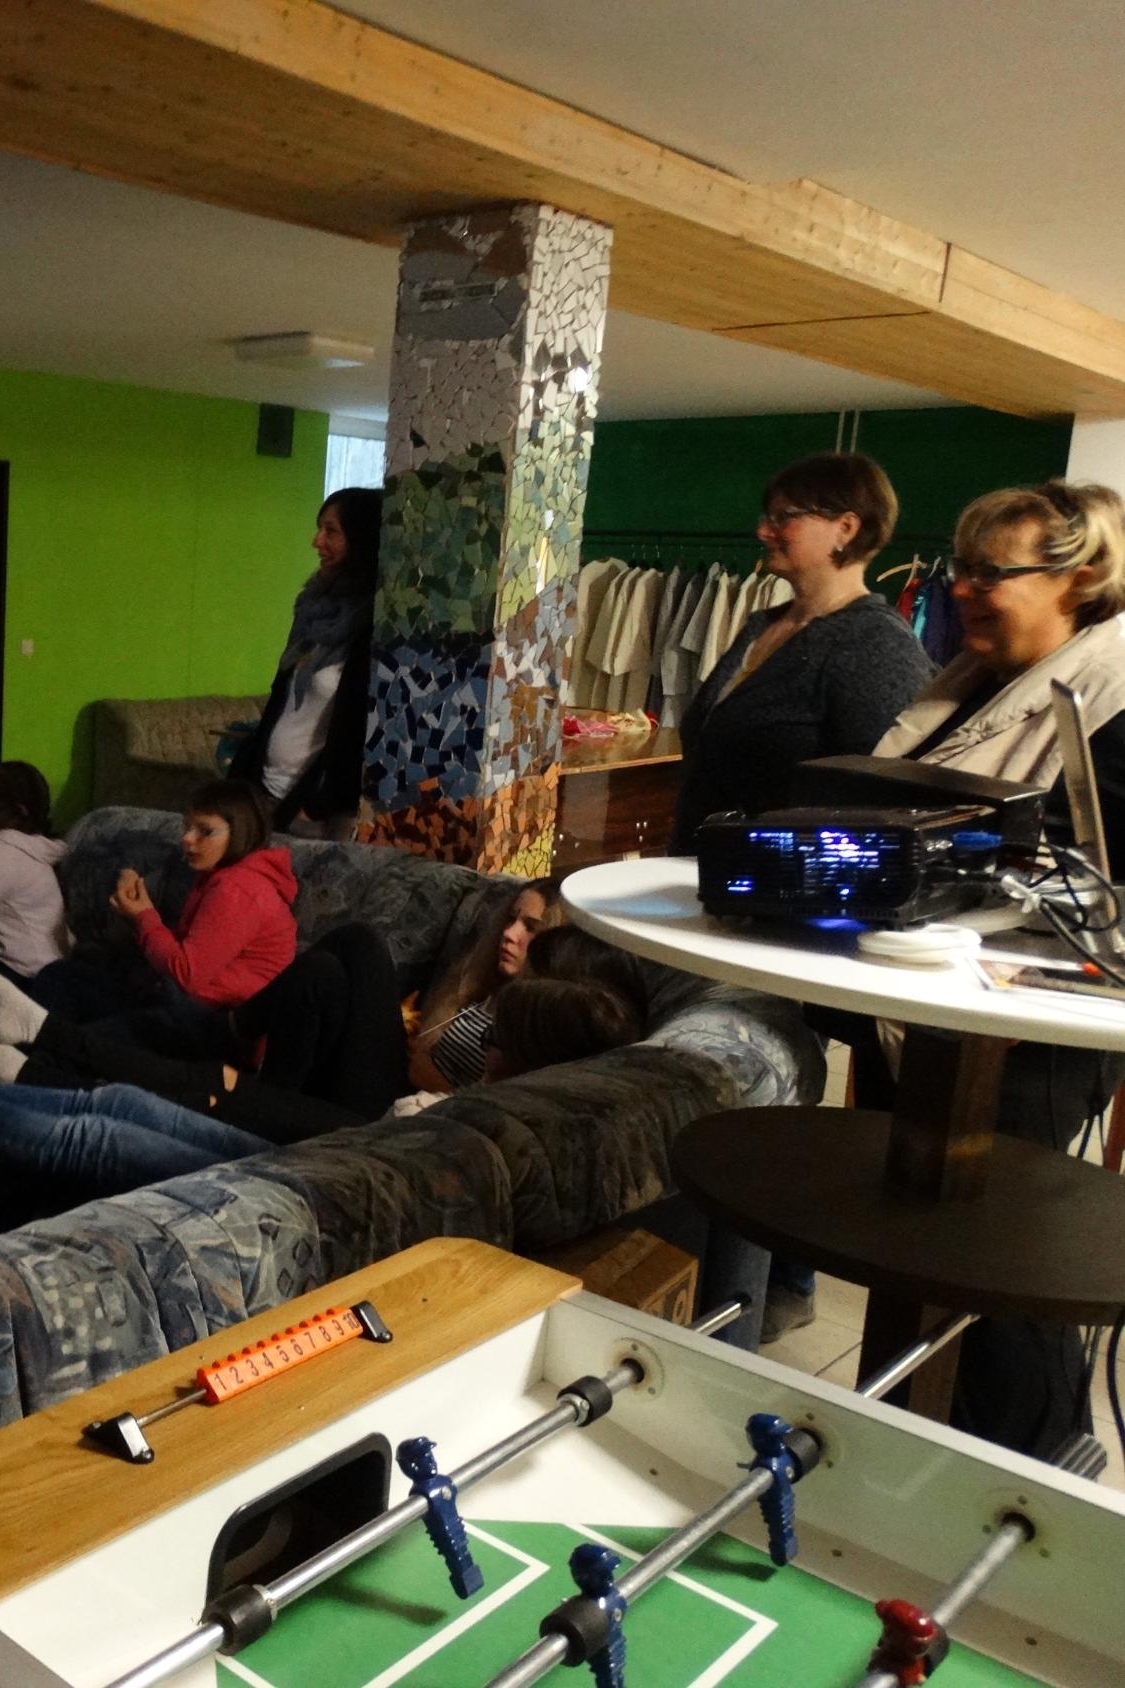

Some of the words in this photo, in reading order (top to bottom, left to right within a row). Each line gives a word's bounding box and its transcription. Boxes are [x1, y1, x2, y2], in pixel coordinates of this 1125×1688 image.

[214, 1373, 227, 1391] 1
[229, 1367, 244, 1385] 2
[245, 1358, 259, 1376] 3
[262, 1352, 274, 1369] 4
[276, 1345, 289, 1362] 5
[290, 1338, 303, 1356] 6
[303, 1331, 316, 1349] 7
[318, 1325, 332, 1342] 8
[331, 1319, 345, 1336] 9
[343, 1312, 360, 1329] 10
